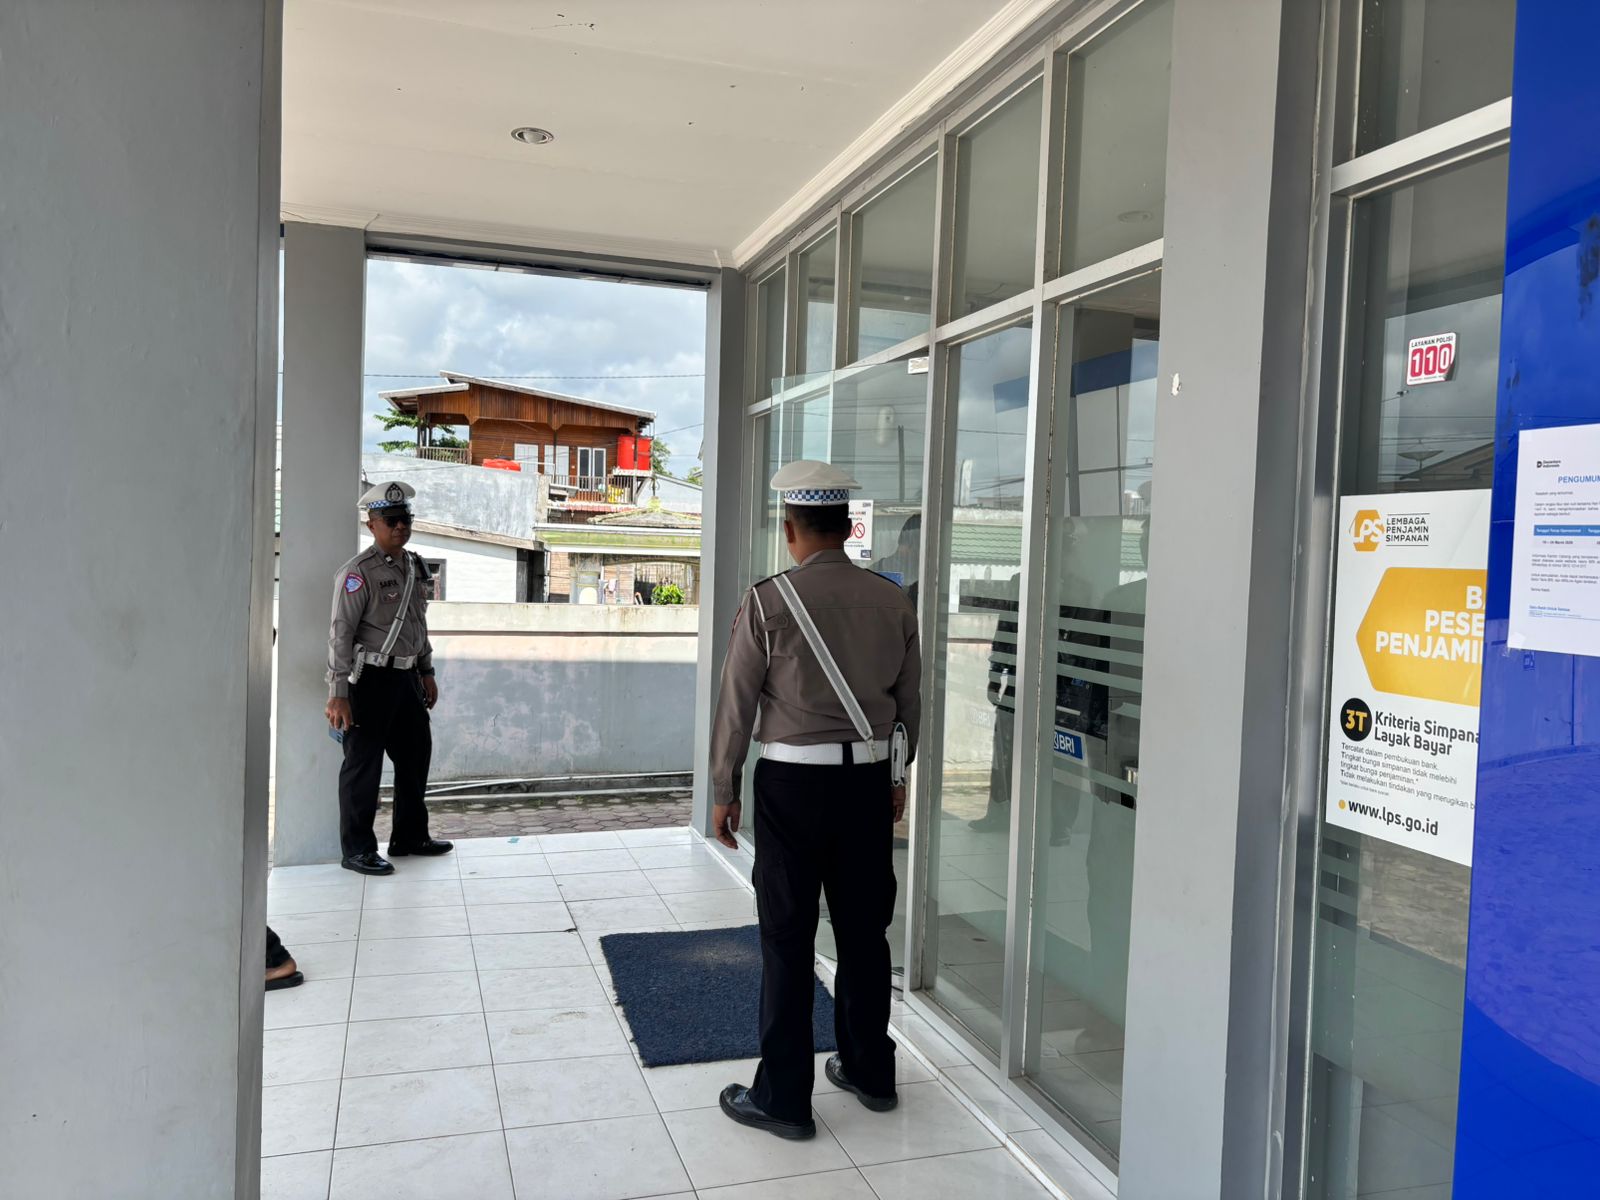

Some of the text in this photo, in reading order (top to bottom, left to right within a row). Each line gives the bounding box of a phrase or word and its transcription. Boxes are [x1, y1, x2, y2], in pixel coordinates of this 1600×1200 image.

[1411, 340, 1435, 348] LAYANAN
[1411, 345, 1452, 377] 110
[1352, 518, 1384, 543] LPS
[1386, 517, 1426, 525] LEMBAGA
[1386, 526, 1429, 534] PENJAMIN
[1385, 534, 1429, 542] SIMPANAN
[1466, 585, 1486, 610] B
[1425, 610, 1485, 637] PESE
[1375, 630, 1483, 664] PENJAMI
[1345, 709, 1368, 732] 3T
[1375, 711, 1421, 732] Kriteria
[1059, 734, 1075, 754] BRI
[1374, 726, 1452, 756] Layak Bayar
[1341, 742, 1364, 754] Tercatat
[1365, 748, 1383, 758] dalam
[1384, 752, 1420, 766] pembukuan
[1340, 761, 1358, 772] tingkat
[1360, 765, 1377, 777] bunga
[1341, 751, 1457, 785] Tingkat bunga simpanan tidak melebihi
[1340, 769, 1355, 780] Tidak
[1356, 774, 1387, 788] melakukan
[1388, 781, 1418, 795] tindakan
[1416, 789, 1432, 800] yang
[1433, 793, 1468, 808] merugikan
[1348, 800, 1438, 836] www.lps.go.id
